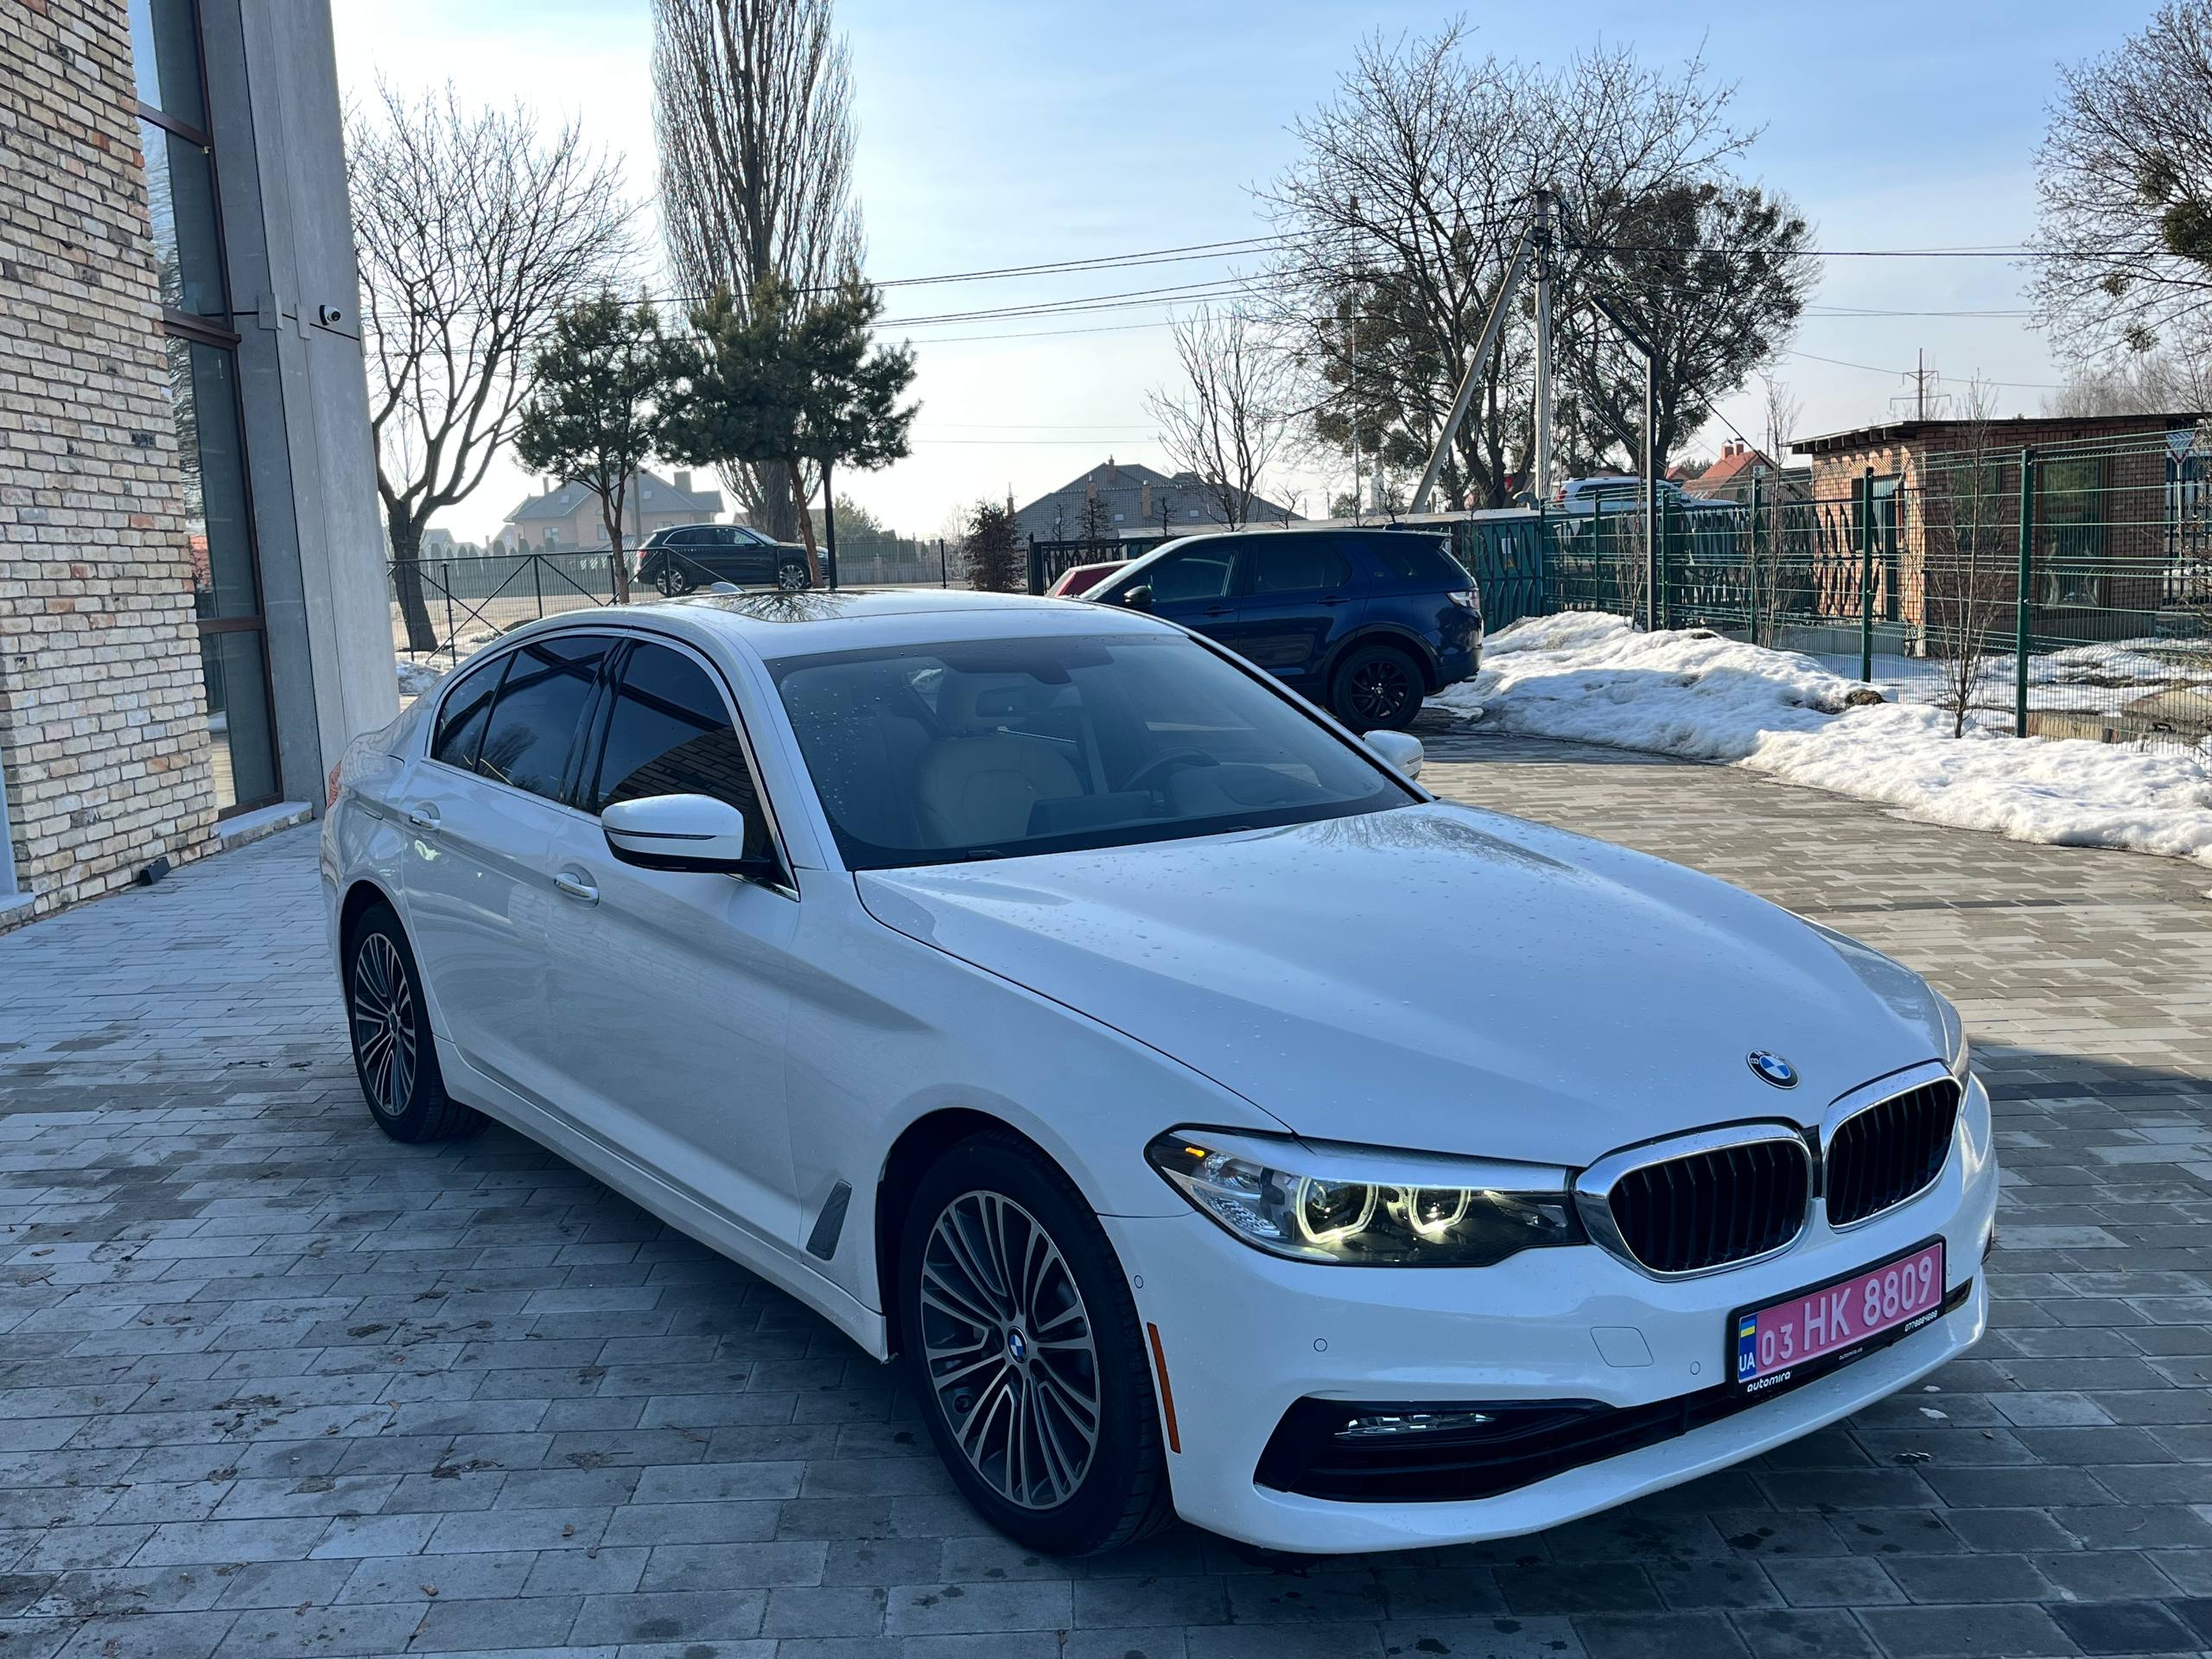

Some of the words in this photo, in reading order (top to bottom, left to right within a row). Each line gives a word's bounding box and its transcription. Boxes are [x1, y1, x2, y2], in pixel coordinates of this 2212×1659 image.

[1761, 1323, 1793, 1366] 03
[1803, 1287, 1851, 1351] HK
[1863, 1256, 1932, 1327] 8809
[1739, 1352, 1756, 1372] UA
[1747, 1371, 1790, 1392] automira
